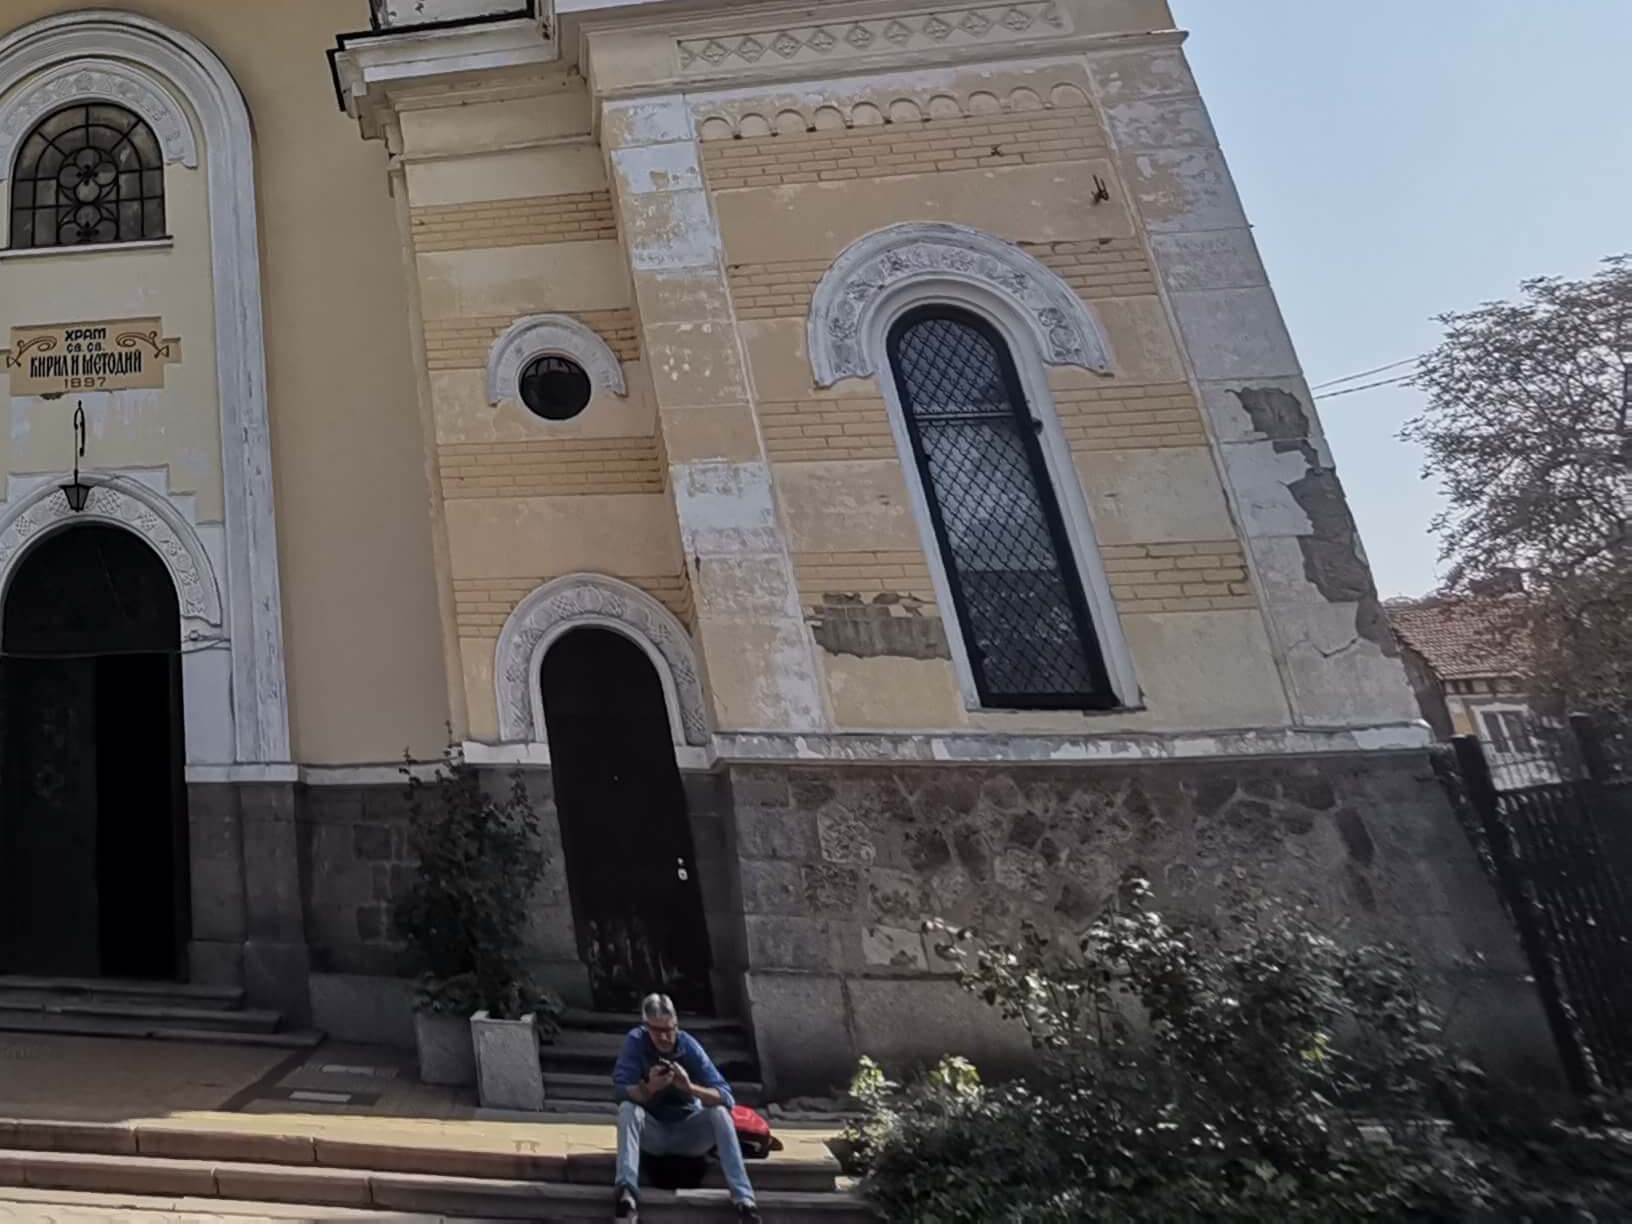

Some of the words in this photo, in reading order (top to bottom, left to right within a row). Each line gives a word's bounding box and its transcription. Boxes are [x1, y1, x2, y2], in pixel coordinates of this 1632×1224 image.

[65, 328, 106, 341] ХРАМ
[30, 355, 68, 378] КИРИЛ
[71, 355, 79, 376] И
[82, 349, 142, 375] МЕТОДИЙ
